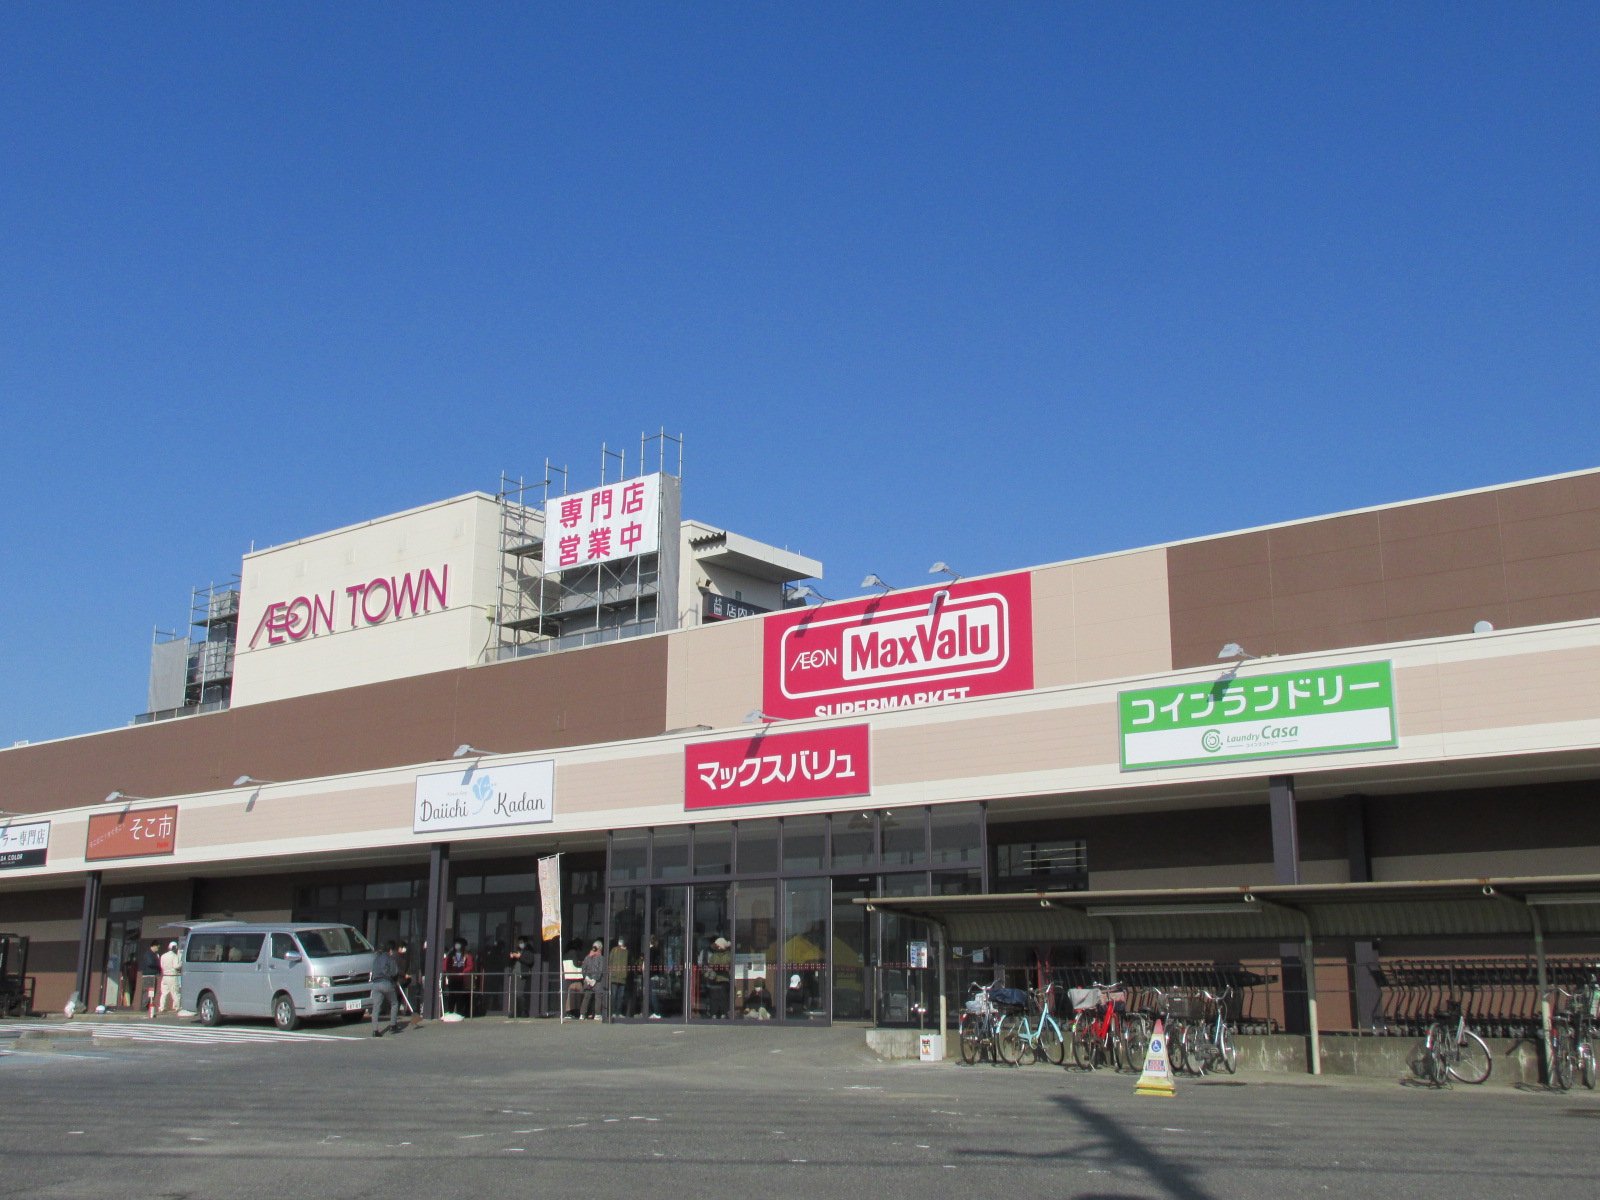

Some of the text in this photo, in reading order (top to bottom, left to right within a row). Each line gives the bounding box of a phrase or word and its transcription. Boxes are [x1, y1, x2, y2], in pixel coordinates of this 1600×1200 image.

[559, 481, 645, 529] 専門店
[558, 521, 643, 567] 営業中
[346, 564, 449, 627] TOWN
[850, 592, 990, 673] MaxValu
[814, 686, 970, 718] SUPERMARKET
[1131, 675, 1380, 725] コインランドリー
[1226, 724, 1299, 746] Laundry Casa
[697, 749, 856, 790] マックスバリュ
[420, 791, 546, 822] Daiichi Kadan
[2, 828, 46, 847] ラー専門店
[129, 813, 174, 840] そこ市
[8, 853, 23, 861] COLOR
